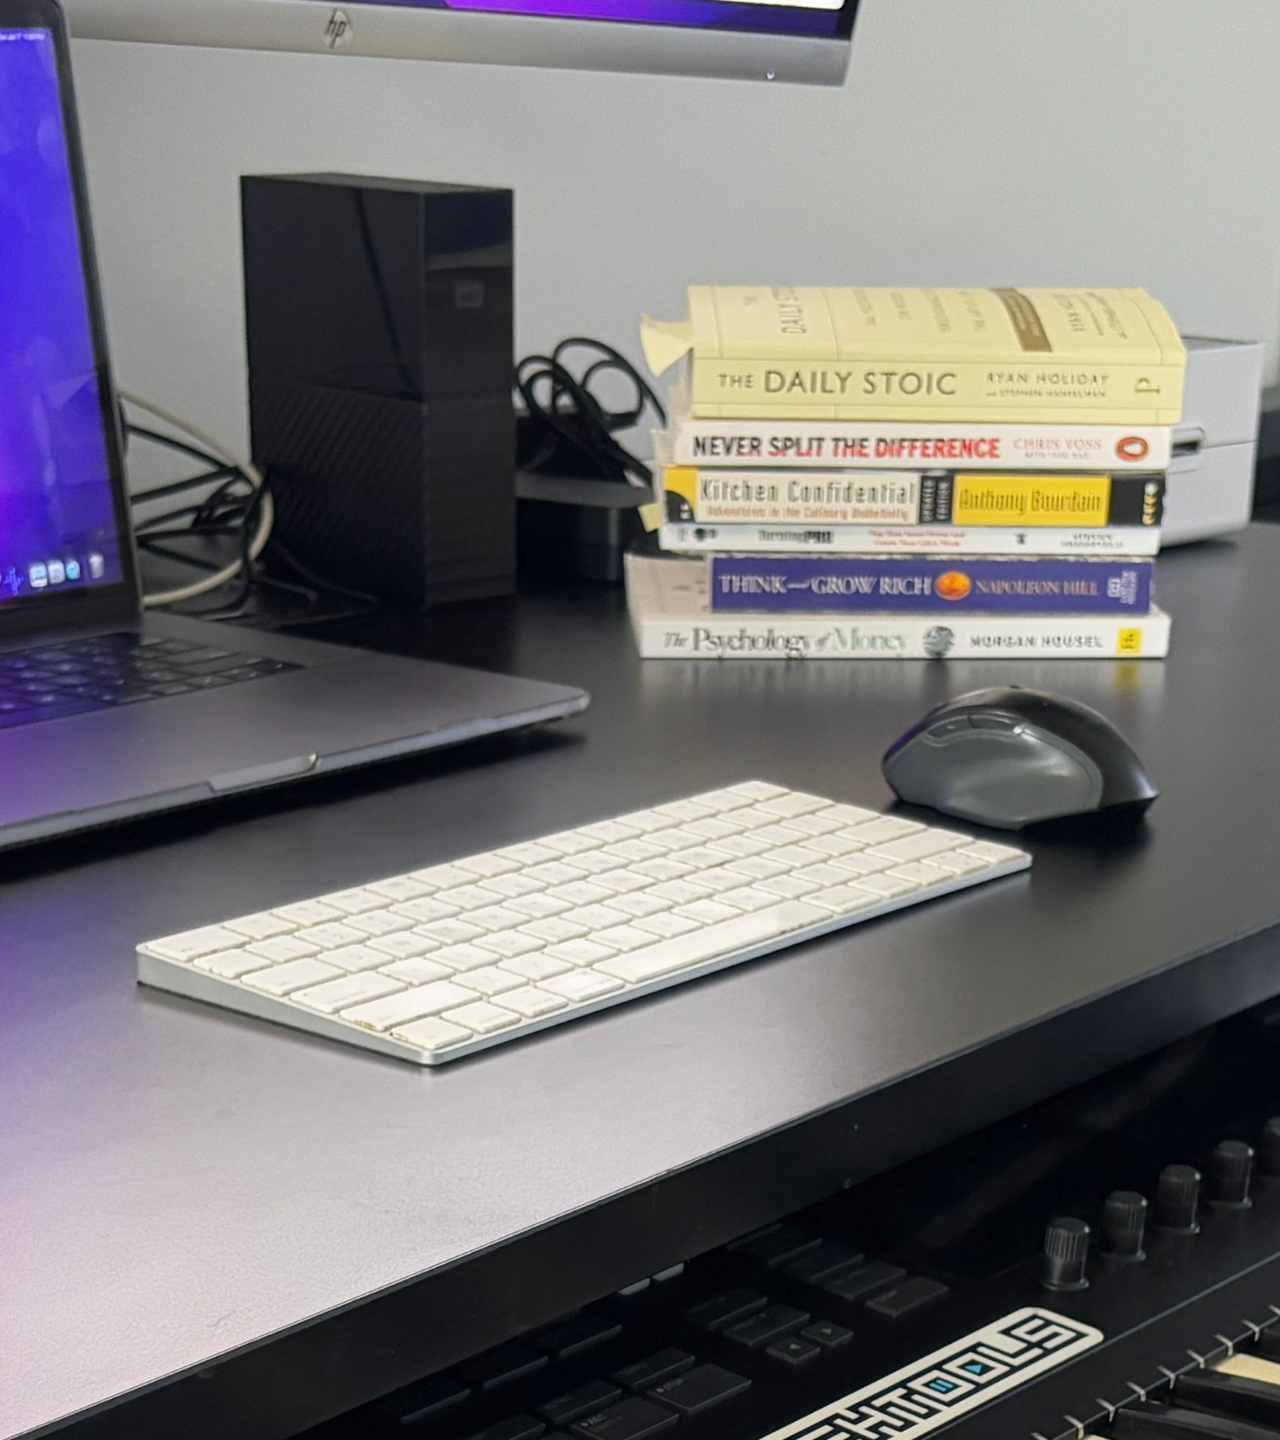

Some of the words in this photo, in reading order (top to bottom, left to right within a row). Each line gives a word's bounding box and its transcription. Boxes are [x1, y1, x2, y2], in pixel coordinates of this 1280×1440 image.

[718, 374, 754, 389] THE
[764, 370, 853, 394] DAILY
[863, 372, 957, 395] STOIC
[986, 373, 1028, 384] RYAN
[1036, 373, 1109, 385] HOLIDAY
[693, 436, 762, 457] NEVER
[769, 437, 824, 458] SPLIT
[831, 437, 870, 459] THE
[875, 438, 1001, 459] DIFFERENCE
[1013, 437, 1060, 450] CHRIS
[1065, 438, 1102, 450] VOSS
[700, 479, 779, 501] Kitchen
[787, 480, 915, 504] Confidential
[959, 489, 1027, 516] Anthony
[1030, 490, 1102, 512] Bourdain
[719, 575, 787, 594] THINK
[810, 576, 877, 595] GROW
[879, 577, 932, 595] RICH
[975, 580, 1060, 595] NAPOLEON
[1063, 581, 1099, 596] HILL
[663, 632, 689, 649] The
[691, 627, 811, 660] Psychology
[832, 627, 907, 658] Money
[970, 634, 1036, 648] MORGAN
[1041, 634, 1104, 648] HOUSEL
